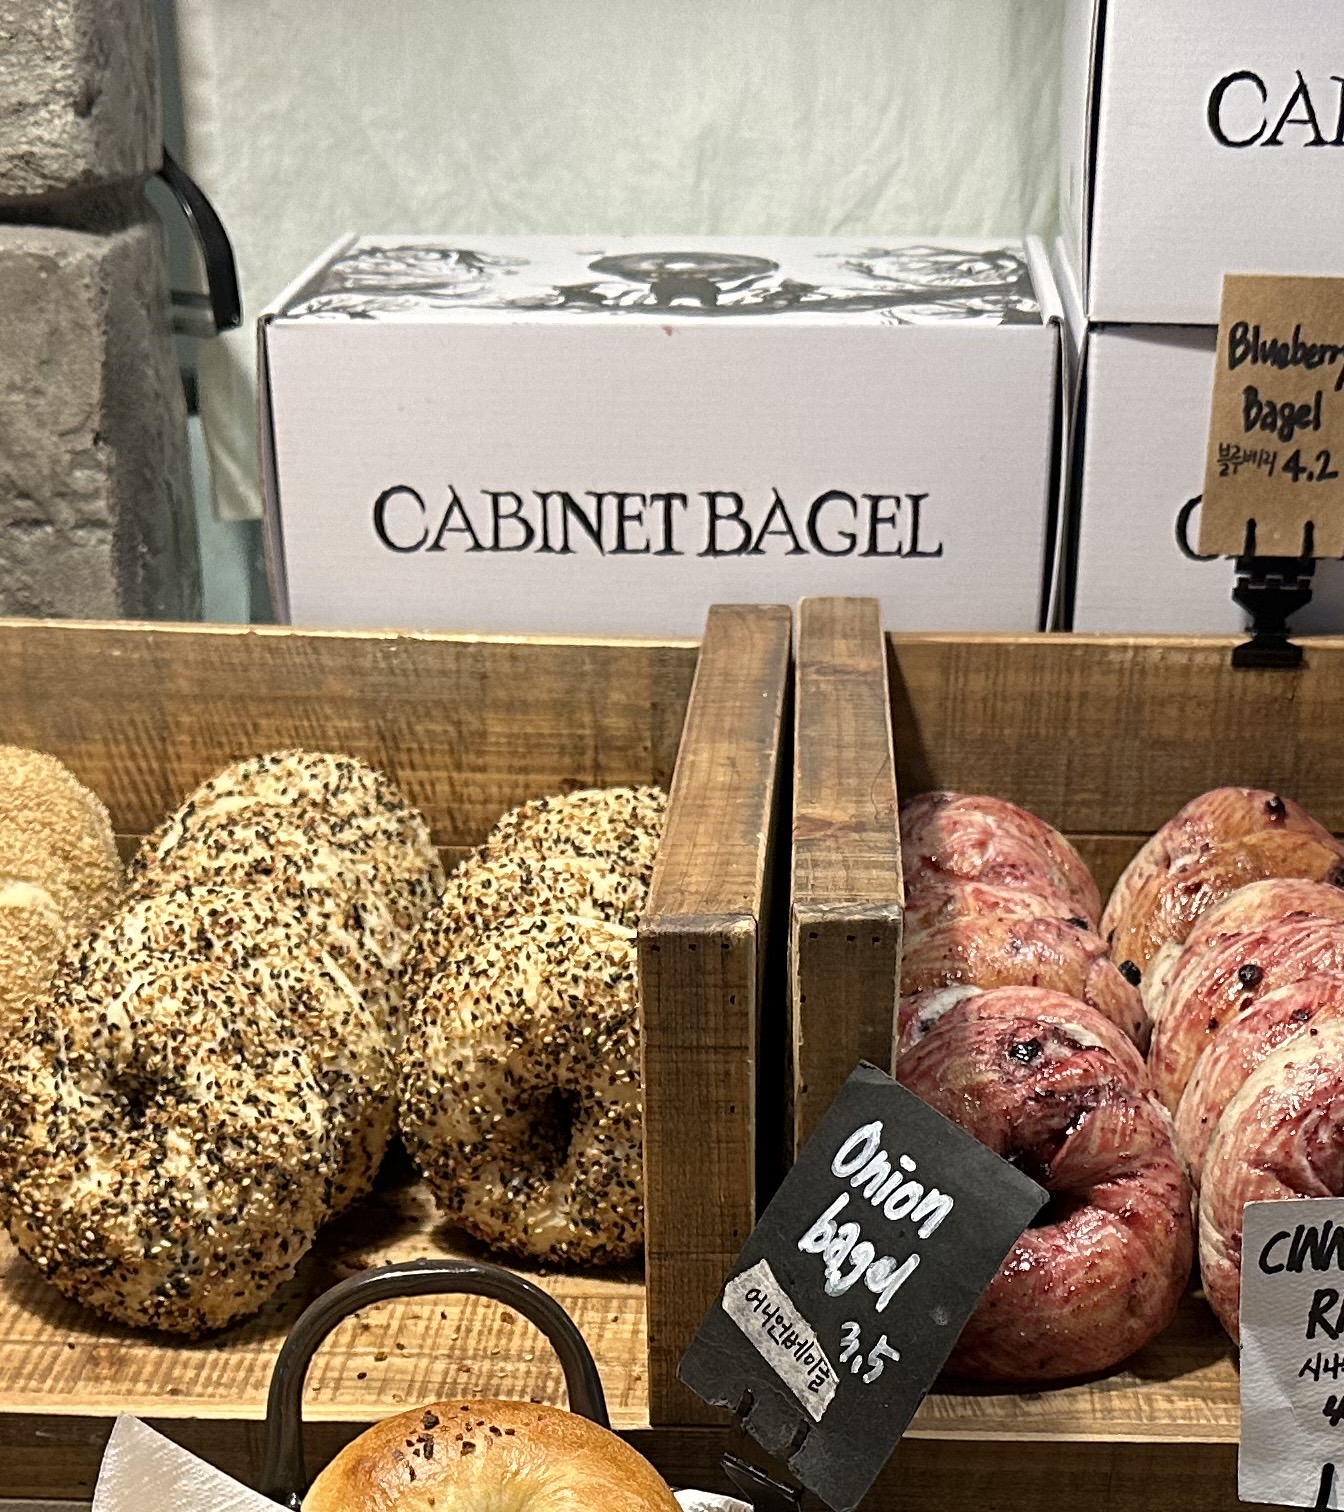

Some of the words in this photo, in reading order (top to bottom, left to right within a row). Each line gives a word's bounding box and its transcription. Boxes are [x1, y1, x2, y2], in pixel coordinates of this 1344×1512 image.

[1243, 385, 1323, 442] Bagel
[1217, 443, 1278, 477] 블루베리
[1282, 449, 1339, 483] 4.2
[373, 485, 687, 556] CABINET
[697, 487, 943, 558] BAGEL
[831, 1121, 954, 1239] Onion
[798, 1192, 920, 1312] bagel
[745, 1288, 830, 1393] 어니언베이글
[840, 1321, 900, 1383] 3.5
